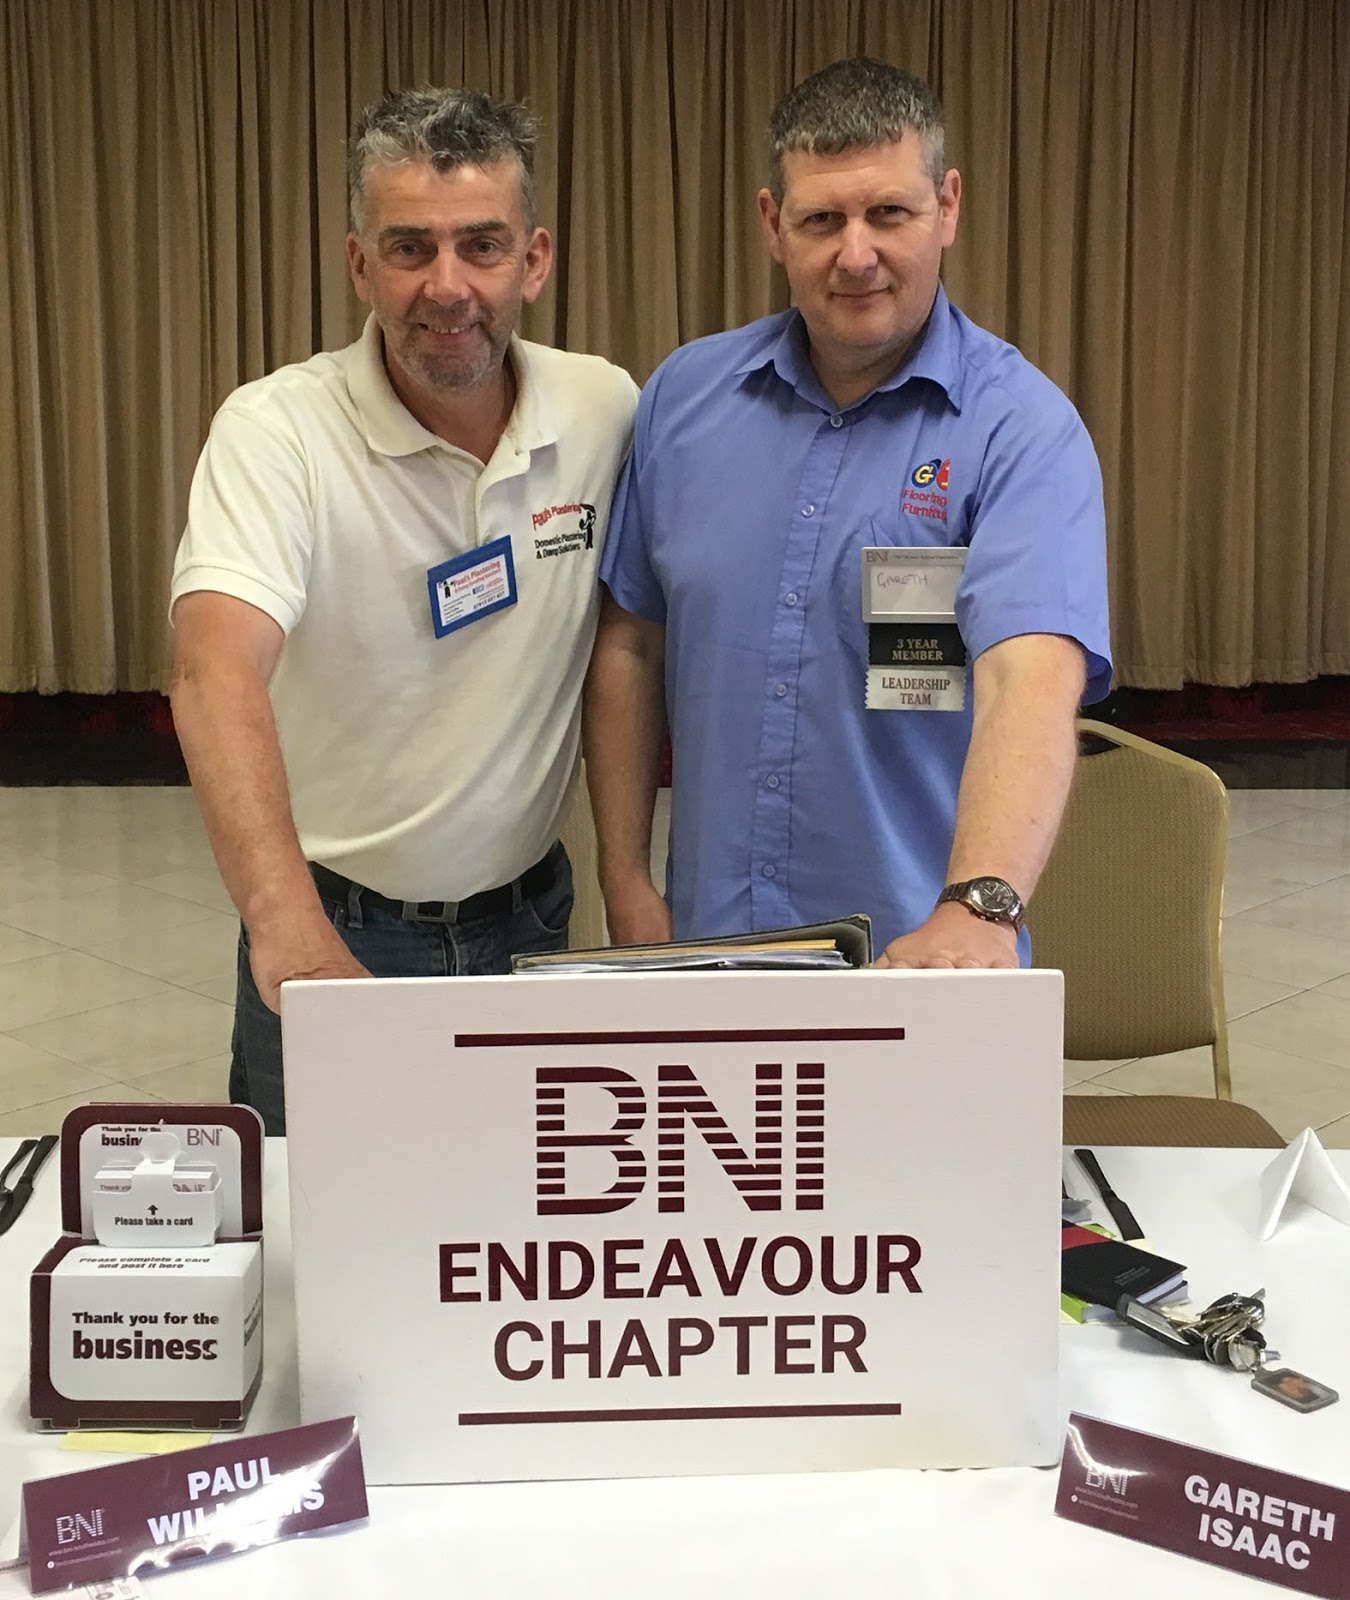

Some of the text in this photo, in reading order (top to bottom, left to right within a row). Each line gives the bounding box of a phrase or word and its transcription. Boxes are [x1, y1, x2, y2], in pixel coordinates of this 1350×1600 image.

[903, 489, 947, 507] Flooring
[551, 504, 582, 515] Plastering
[535, 533, 586, 548] Domestic Plastering
[536, 551, 542, 559] &
[558, 543, 580, 554] Solutions
[866, 551, 889, 562] BNI
[877, 572, 928, 588] GARETH
[897, 639, 938, 650] 3 YEAR
[892, 650, 943, 661] MEMBER
[882, 677, 951, 691] LEADERSHIP
[900, 693, 931, 705] TEAM
[187, 1128, 220, 1146] BNI
[536, 1063, 824, 1215] BNI
[114, 1217, 143, 1225] Please
[145, 1217, 164, 1225] take
[174, 1217, 193, 1225] card
[439, 1235, 923, 1302] ENDEAVOUR
[72, 1312, 219, 1326] Thank you for the
[73, 1330, 218, 1360] business
[494, 1315, 868, 1381] CHAPTER
[187, 1456, 282, 1501] PAUL
[1184, 1474, 1336, 1541] GARETH
[56, 1508, 103, 1545] BNI
[1198, 1514, 1311, 1570] ISAAC
